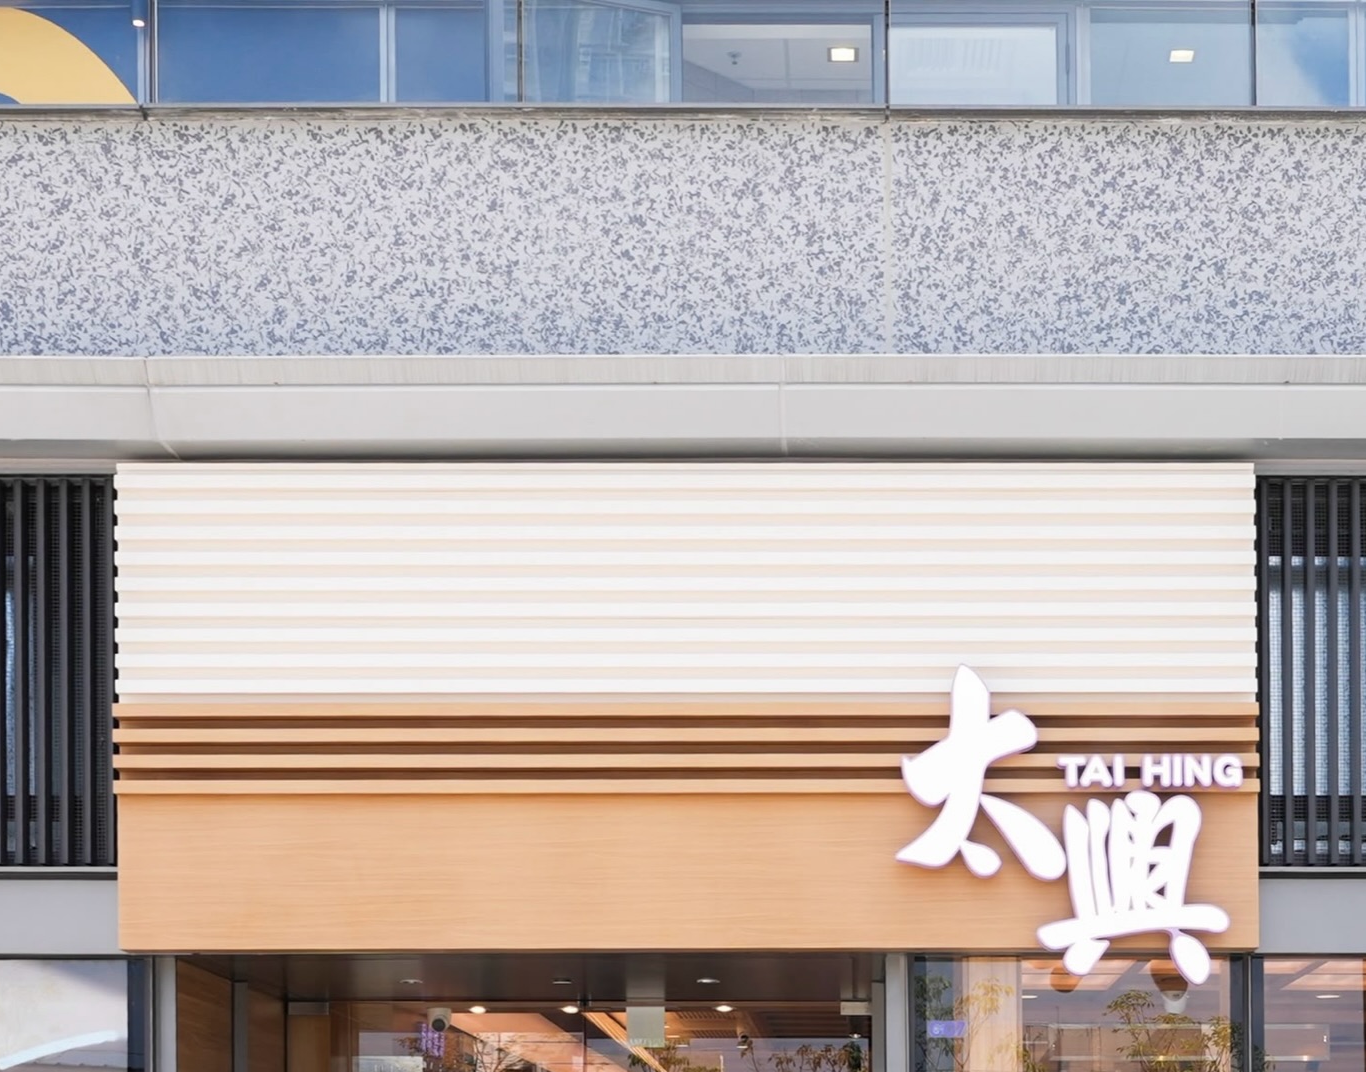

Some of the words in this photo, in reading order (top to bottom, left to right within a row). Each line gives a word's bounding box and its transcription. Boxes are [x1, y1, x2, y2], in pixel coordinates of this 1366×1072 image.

[895, 663, 1230, 986] 太興
[1057, 753, 1126, 789] TAI
[1141, 753, 1244, 789] HING
